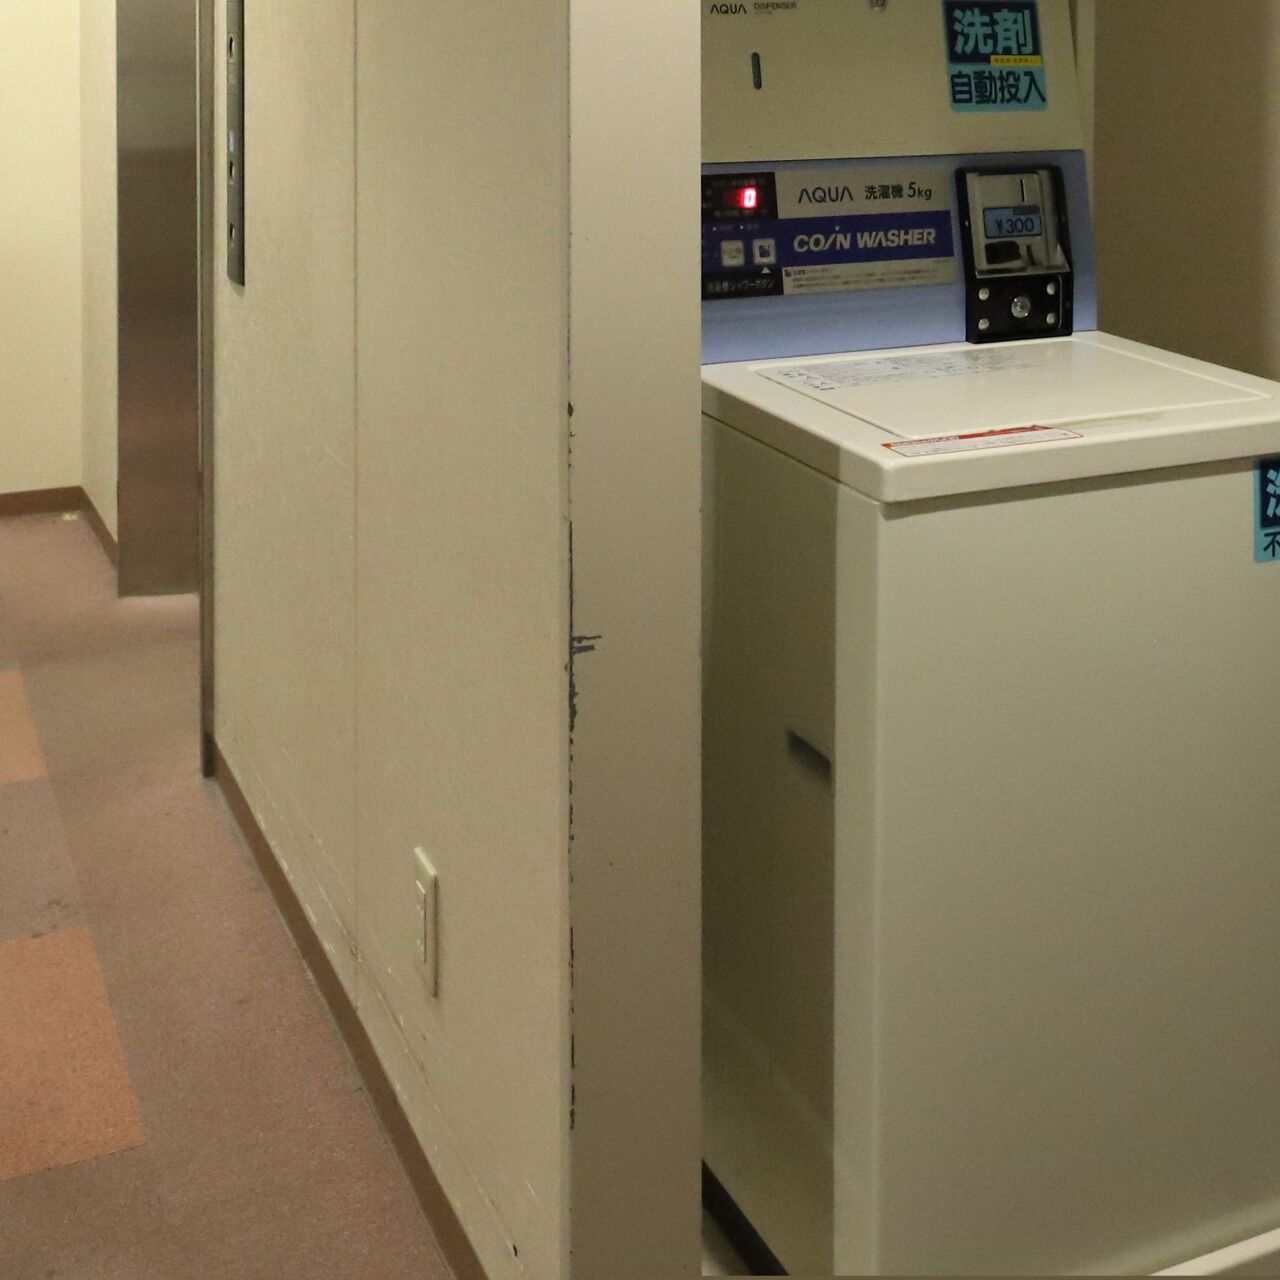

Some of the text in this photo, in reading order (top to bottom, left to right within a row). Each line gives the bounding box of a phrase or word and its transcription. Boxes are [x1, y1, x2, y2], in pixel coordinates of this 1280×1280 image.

[710, 3, 748, 15] AQUA
[952, 7, 1033, 55] 洗剤
[950, 70, 1047, 105] 自動投入
[744, 187, 757, 208] 0
[798, 181, 932, 204] AQUA 洗濯機 5kg
[793, 225, 937, 253] COIN WASHER
